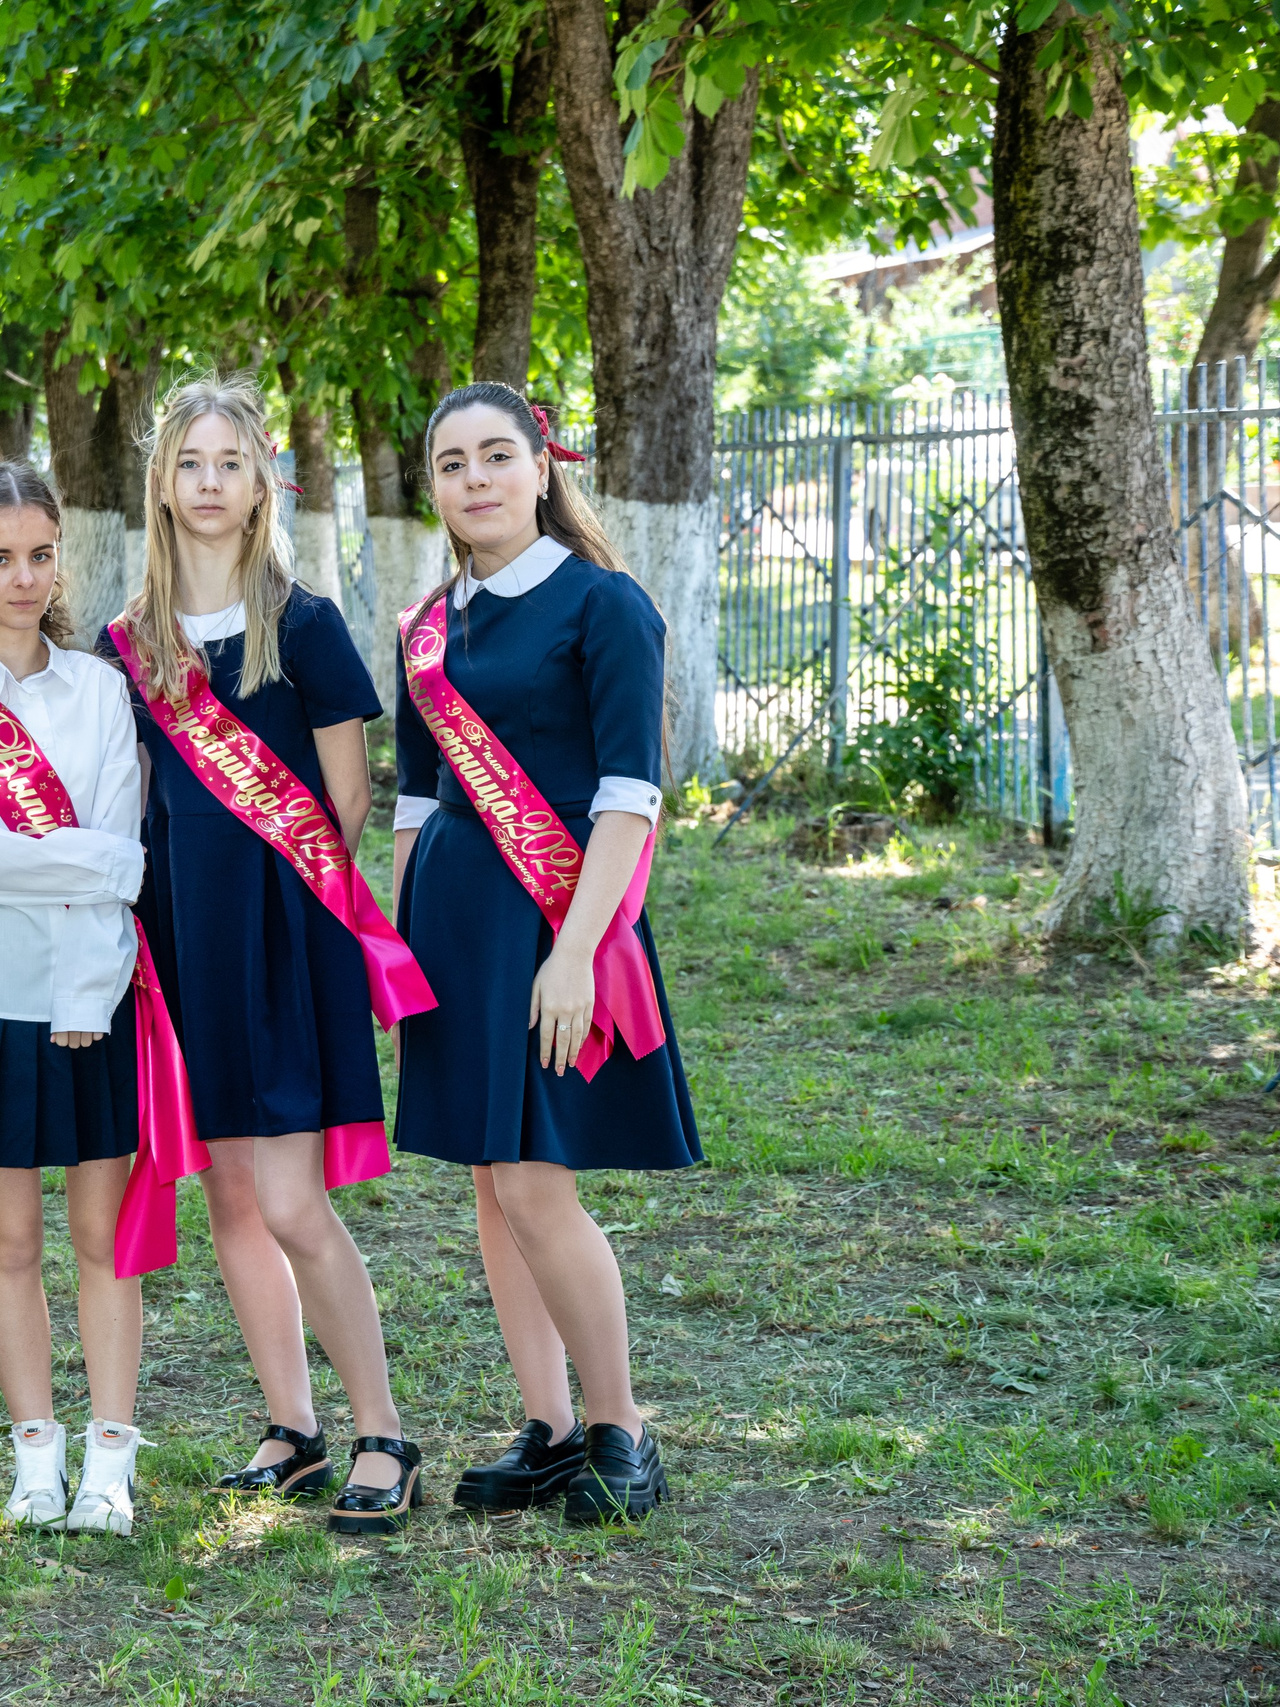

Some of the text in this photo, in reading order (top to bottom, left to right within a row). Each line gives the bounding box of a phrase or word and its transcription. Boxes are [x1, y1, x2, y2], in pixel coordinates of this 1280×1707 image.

[200, 705, 215, 715] 9
[446, 706, 461, 716] 9
[161, 676, 349, 875] пускница 2024
[60, 813, 73, 822] 9
[255, 817, 316, 882] Краснодар
[491, 823, 546, 898] Краснодар
[505, 810, 581, 892] 2024
